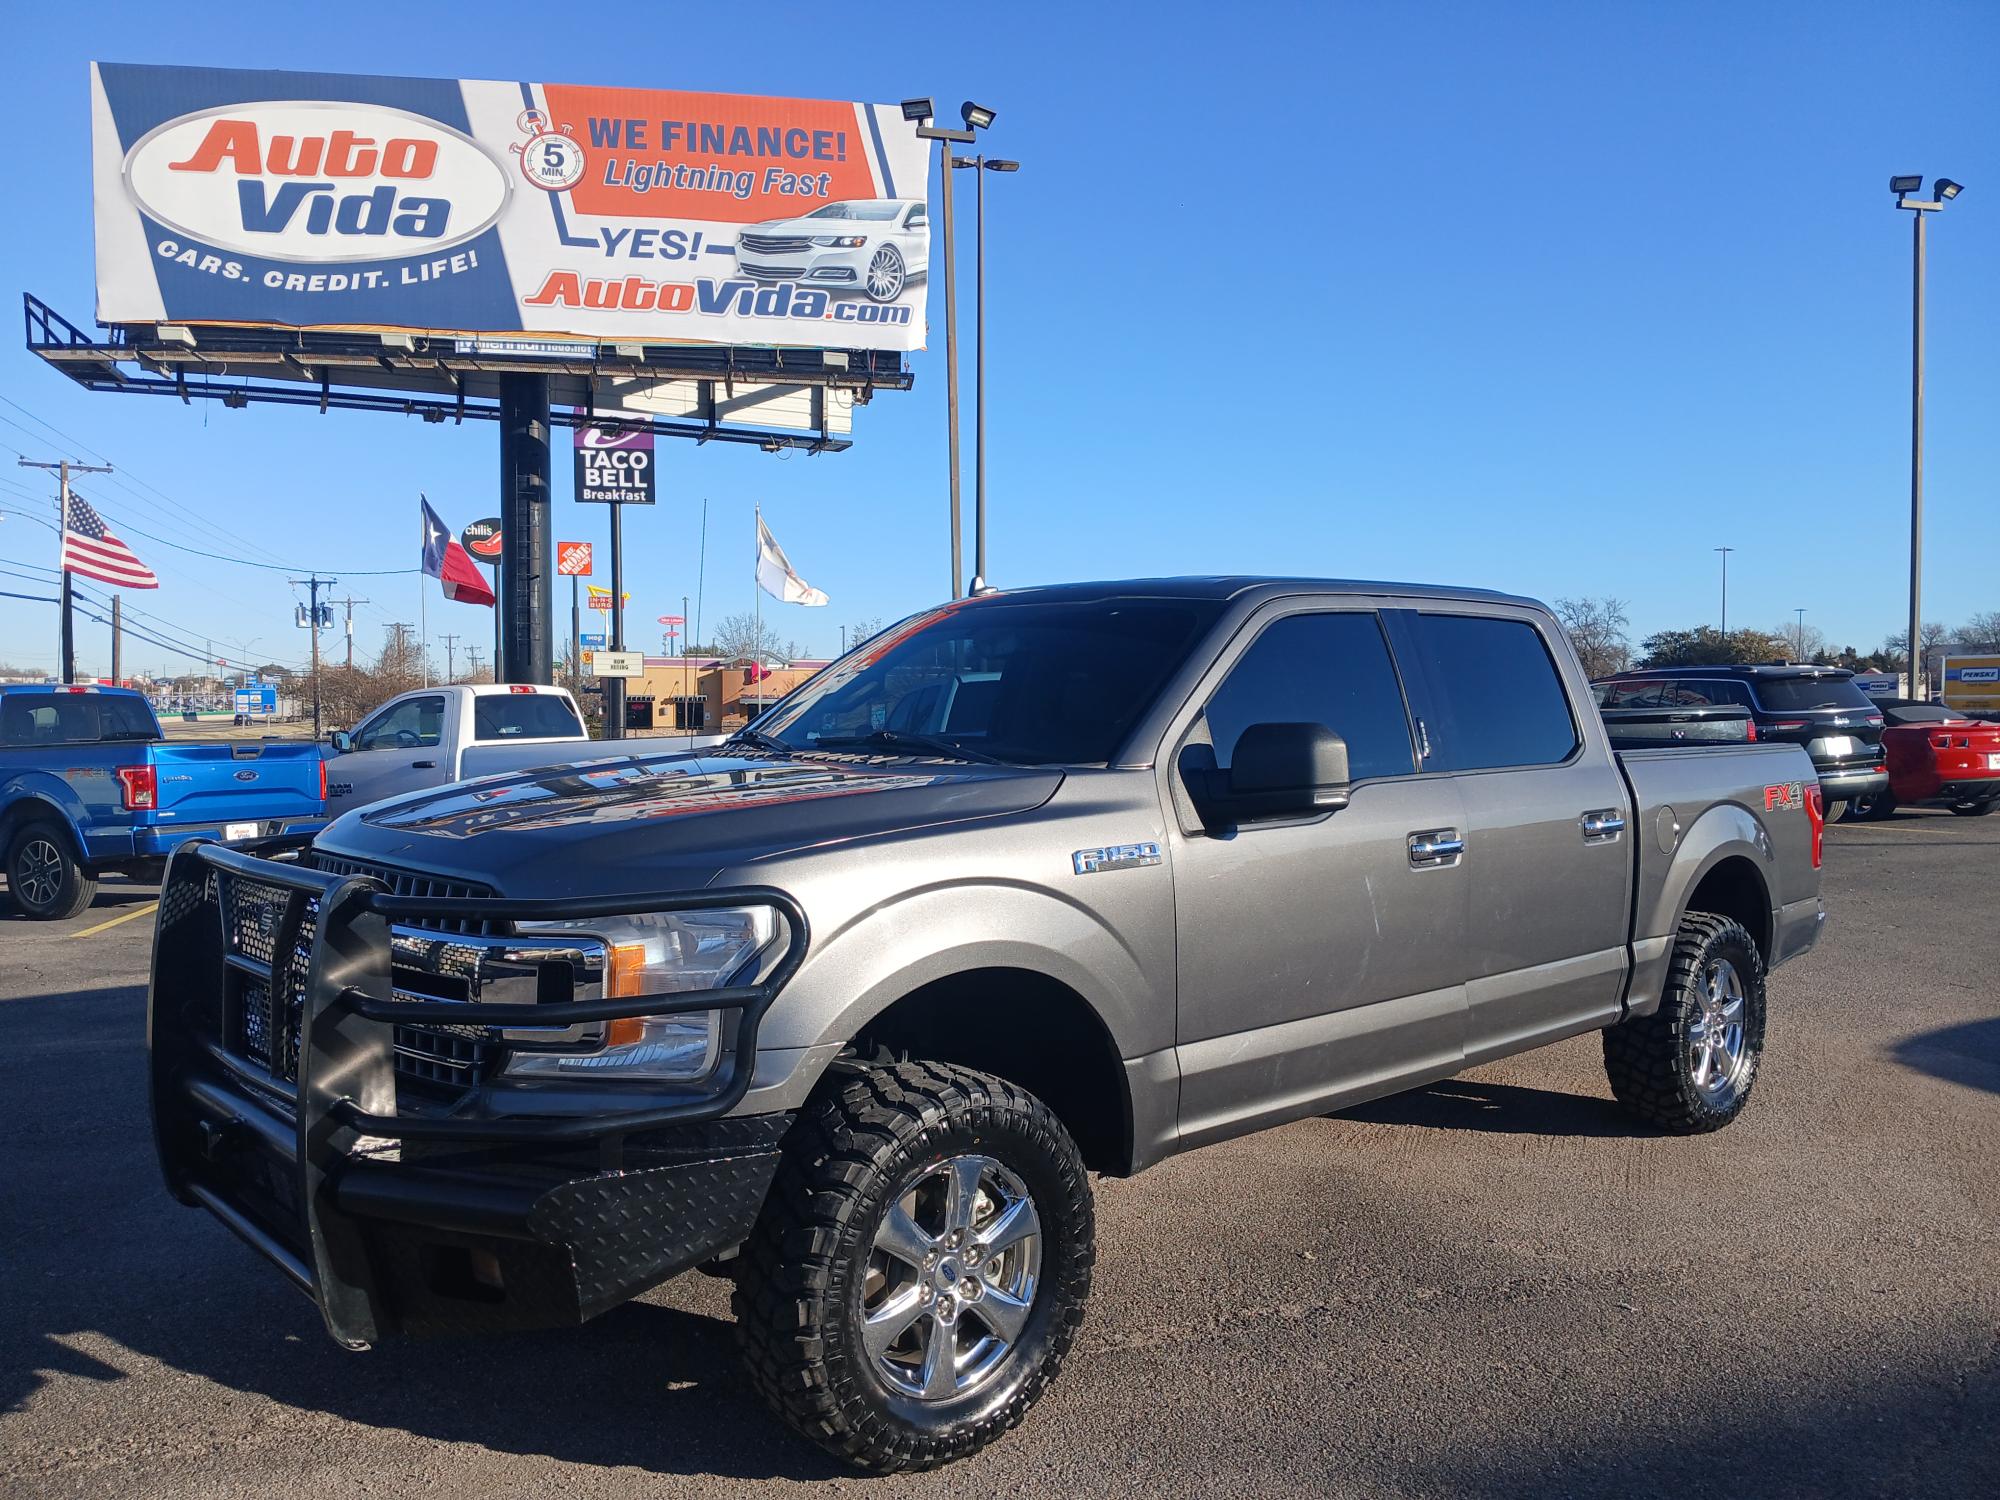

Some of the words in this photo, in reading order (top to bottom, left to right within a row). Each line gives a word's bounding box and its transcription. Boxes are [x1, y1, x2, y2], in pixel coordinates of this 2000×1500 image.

[168, 120, 438, 178] Auto
[588, 117, 648, 150] WE
[661, 120, 847, 162] FINANCE!
[543, 143, 565, 168] 5
[541, 167, 566, 177] MIN.
[602, 159, 755, 200] Lightning
[761, 168, 831, 198] Fast
[238, 179, 451, 238] Vida
[600, 227, 703, 261] YES!
[157, 240, 250, 282] CARS.
[263, 270, 389, 292] CREDIT.
[401, 250, 478, 286] LIFE!
[523, 270, 913, 326] AutoVida.com
[579, 449, 648, 470] TACO
[585, 468, 648, 488] BELL
[583, 488, 647, 501] Breakfast
[465, 524, 493, 536] chili's
[558, 543, 591, 574] HOME
[571, 555, 591, 575] DEPOT
[1764, 782, 1803, 812] FX4
